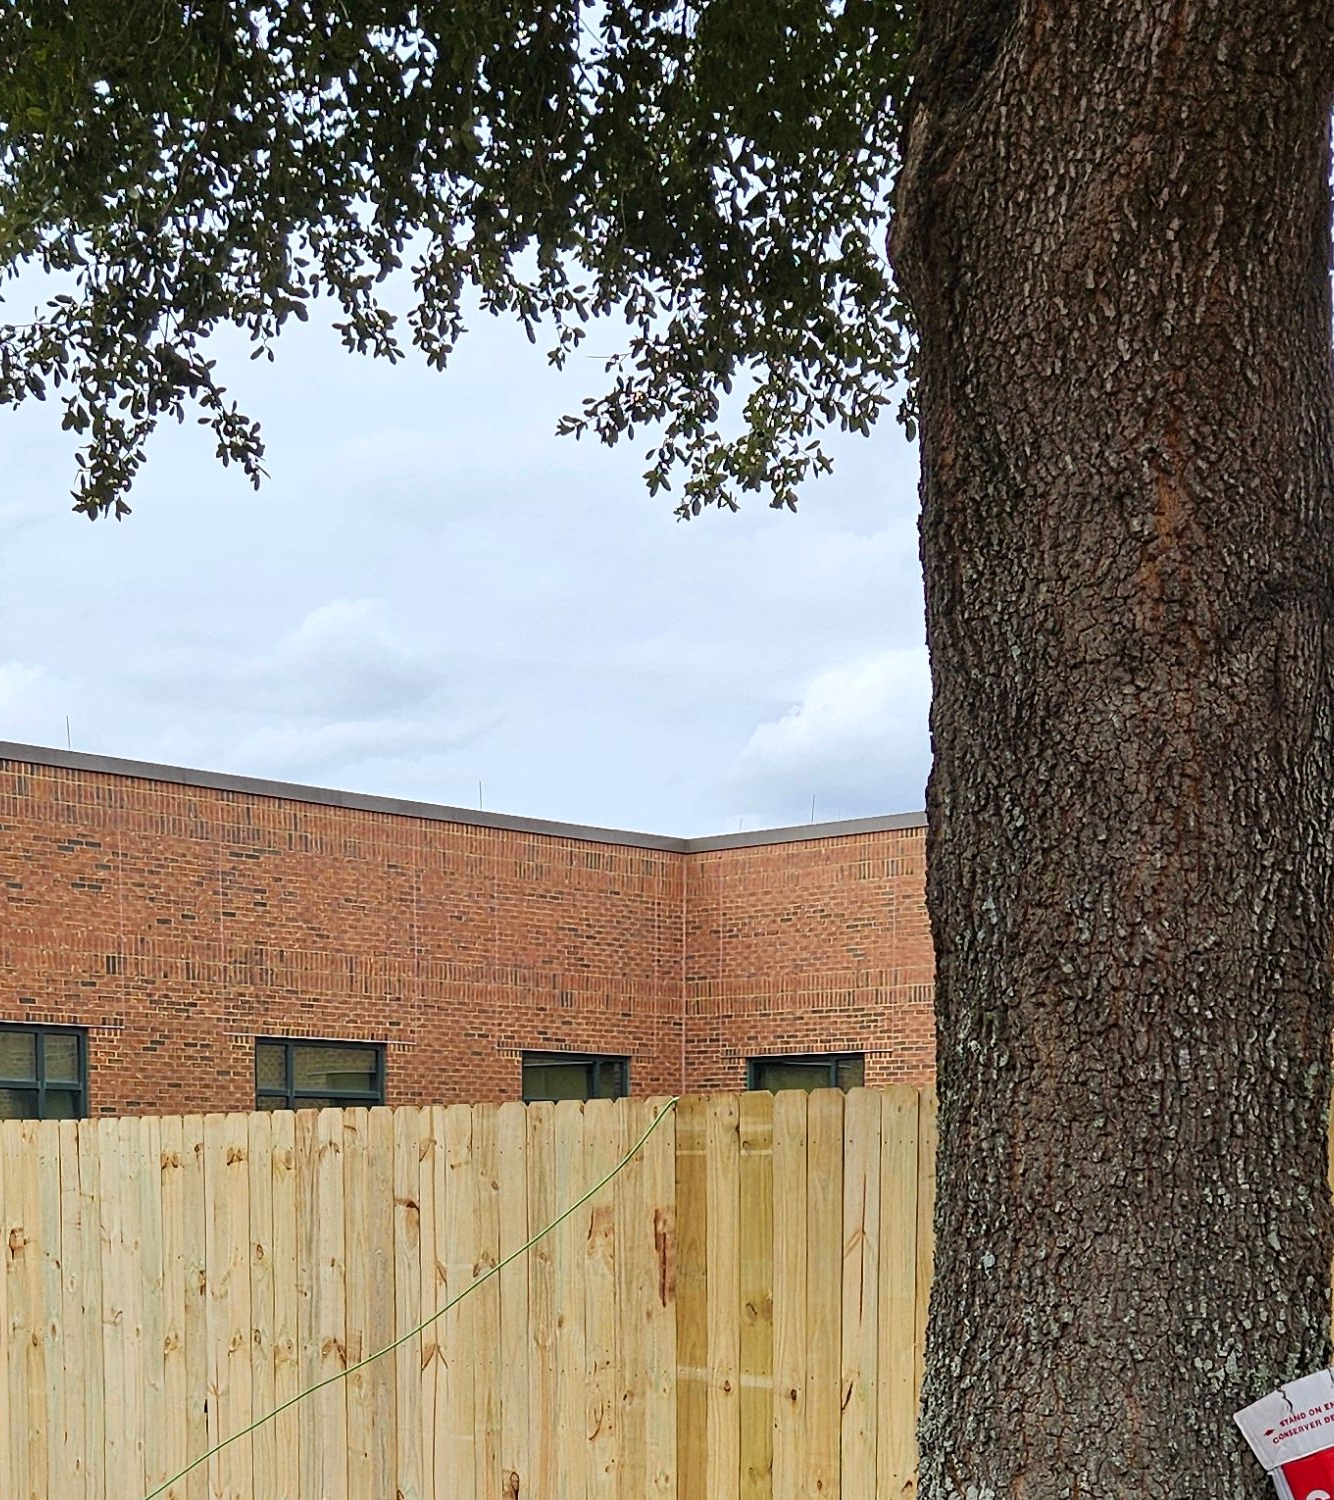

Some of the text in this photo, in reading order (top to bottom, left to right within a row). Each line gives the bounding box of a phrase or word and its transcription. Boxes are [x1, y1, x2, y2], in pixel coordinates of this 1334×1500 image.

[1279, 1414, 1307, 1427] STAND
[1309, 1406, 1323, 1417] ON
[1272, 1420, 1322, 1444] CONSERVER
